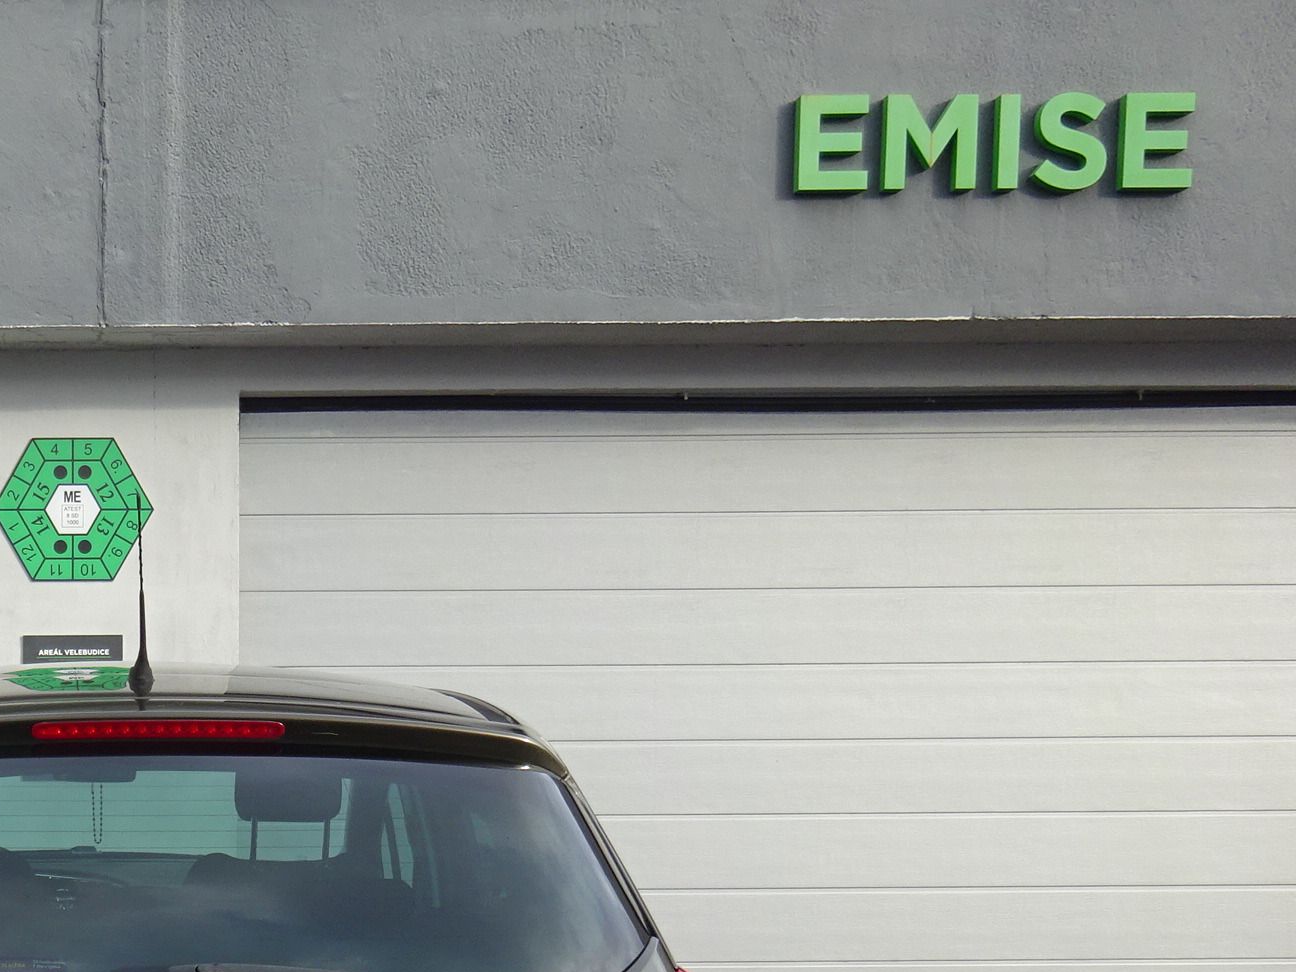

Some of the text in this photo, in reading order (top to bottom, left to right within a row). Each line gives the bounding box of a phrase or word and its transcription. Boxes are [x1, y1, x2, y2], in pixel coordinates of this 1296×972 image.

[793, 91, 1197, 195] EMISE
[50, 443, 60, 456] 4
[83, 443, 93, 456] 5
[22, 460, 36, 472] 3
[7, 489, 20, 502] 2
[32, 482, 50, 501] 15
[63, 491, 82, 503] ME
[95, 482, 114, 503] 12
[31, 515, 51, 536] 14
[96, 517, 115, 536] 13
[21, 544, 37, 562] 12
[49, 564, 64, 576] 11
[80, 563, 96, 577] 10
[38, 647, 110, 656] AREÁL VELEBUDICE
